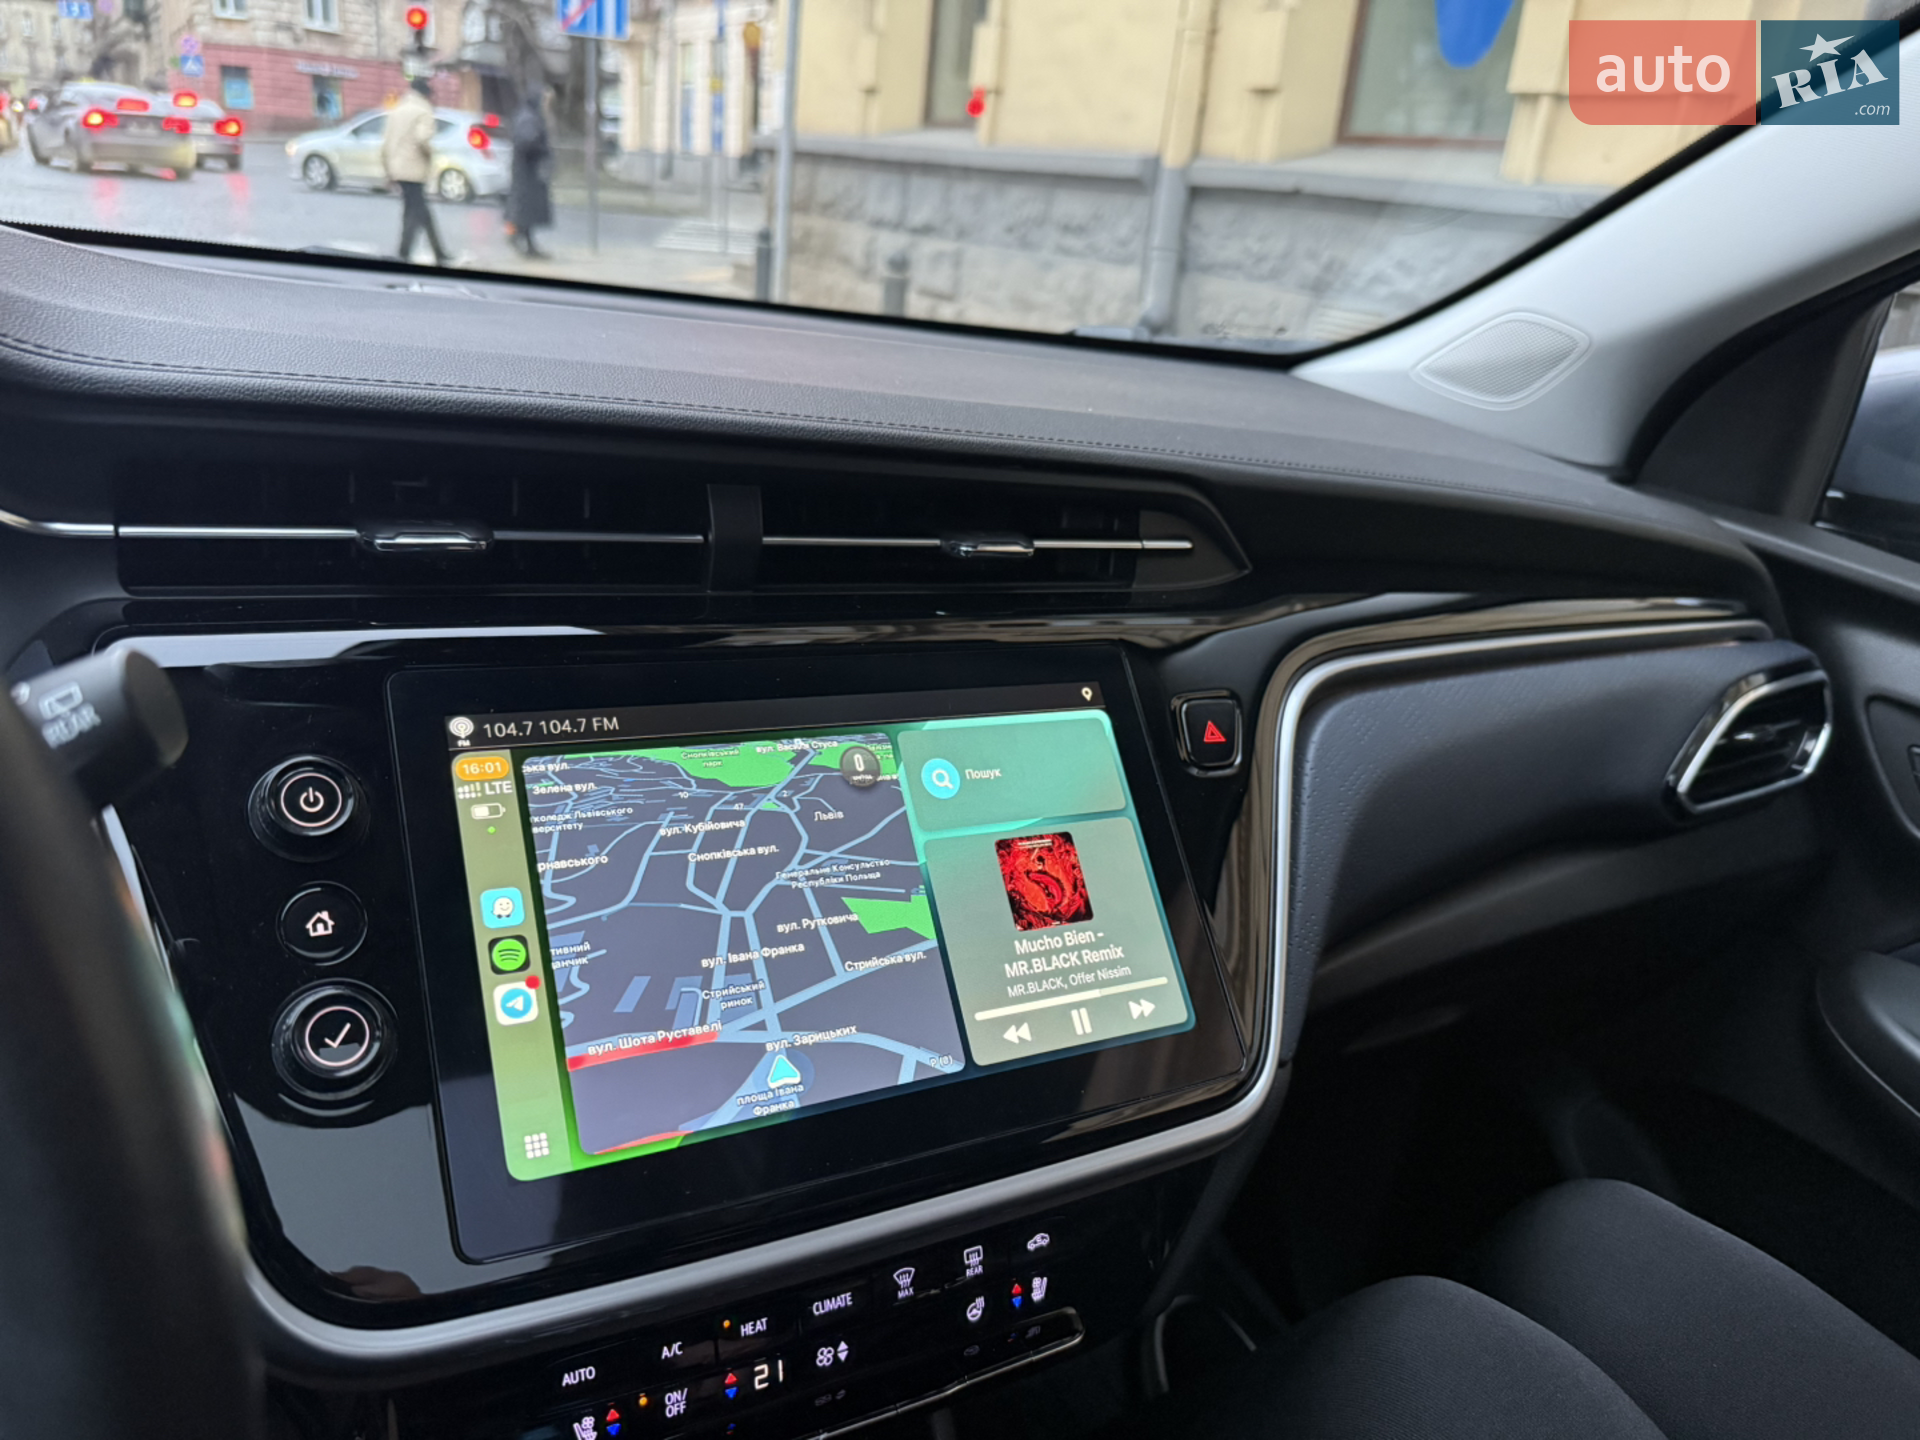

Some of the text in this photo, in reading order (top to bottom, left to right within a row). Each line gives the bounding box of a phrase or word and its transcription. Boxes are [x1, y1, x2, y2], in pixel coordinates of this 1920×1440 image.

[483, 716, 620, 738] 104.7 104.7 FM
[756, 742, 777, 753] вул.
[811, 738, 839, 750] Стуса
[462, 761, 502, 775] 16:01
[547, 762, 571, 773] вул.
[853, 753, 865, 772] 0
[965, 767, 1002, 781] Пошук
[485, 780, 513, 796] LTE
[532, 782, 598, 795] Зелена вул.
[814, 810, 844, 822] Львів
[659, 819, 746, 837] вул. Кубійовича
[687, 844, 780, 862] Снопківська вул.
[537, 855, 609, 873] рнавського
[776, 912, 859, 934] вул. Рутковича
[1014, 934, 1063, 955] Mucho
[1064, 929, 1096, 946] Bien
[701, 943, 805, 969] вул. Івана Франка
[844, 951, 927, 972] Стрийська вул.
[1004, 943, 1125, 978] MR.BLACK Remix
[702, 981, 765, 999] Стрийський
[1006, 964, 1132, 998] MR.BLACK, Offer Nissim
[720, 996, 753, 1011] ринок
[587, 1020, 723, 1056] вул. Шота Руставелі
[765, 1025, 858, 1052] вул. Зарицьких
[736, 1083, 805, 1107] площа Івана
[752, 1099, 796, 1117] Франка
[966, 1265, 983, 1278] REAR
[897, 1287, 914, 1299] MAX
[812, 1291, 854, 1316] CLIMATE
[740, 1317, 768, 1337] HEAT
[660, 1341, 684, 1360] A/C
[561, 1366, 596, 1387] AUTO
[753, 1359, 784, 1390] 21
[664, 1388, 688, 1405] ON/
[665, 1402, 687, 1418] OFF
